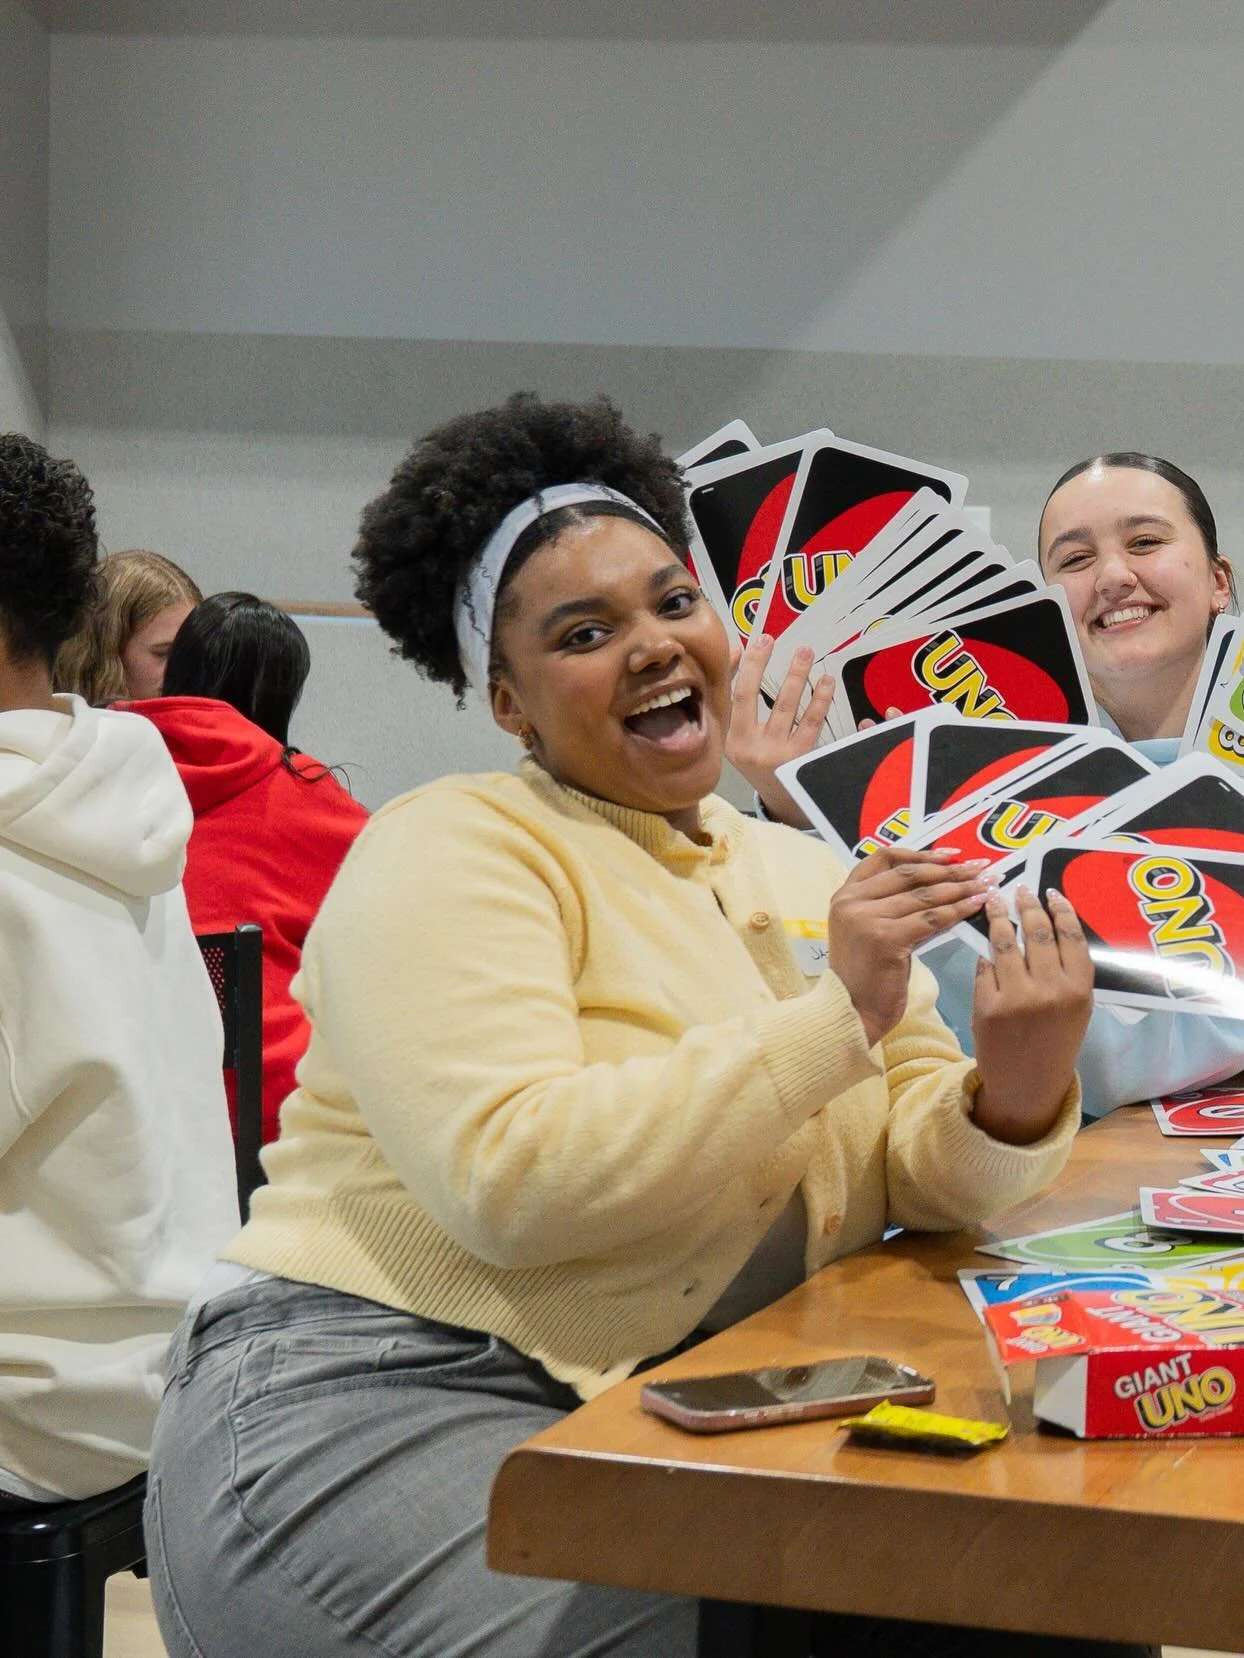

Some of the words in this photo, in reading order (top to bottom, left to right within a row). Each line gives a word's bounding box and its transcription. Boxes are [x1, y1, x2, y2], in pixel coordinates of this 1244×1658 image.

[911, 629, 1017, 720] UN
[1085, 1305, 1184, 1343] GIANT
[1114, 1352, 1192, 1399] GIANT
[1134, 1366, 1236, 1432] UNO
